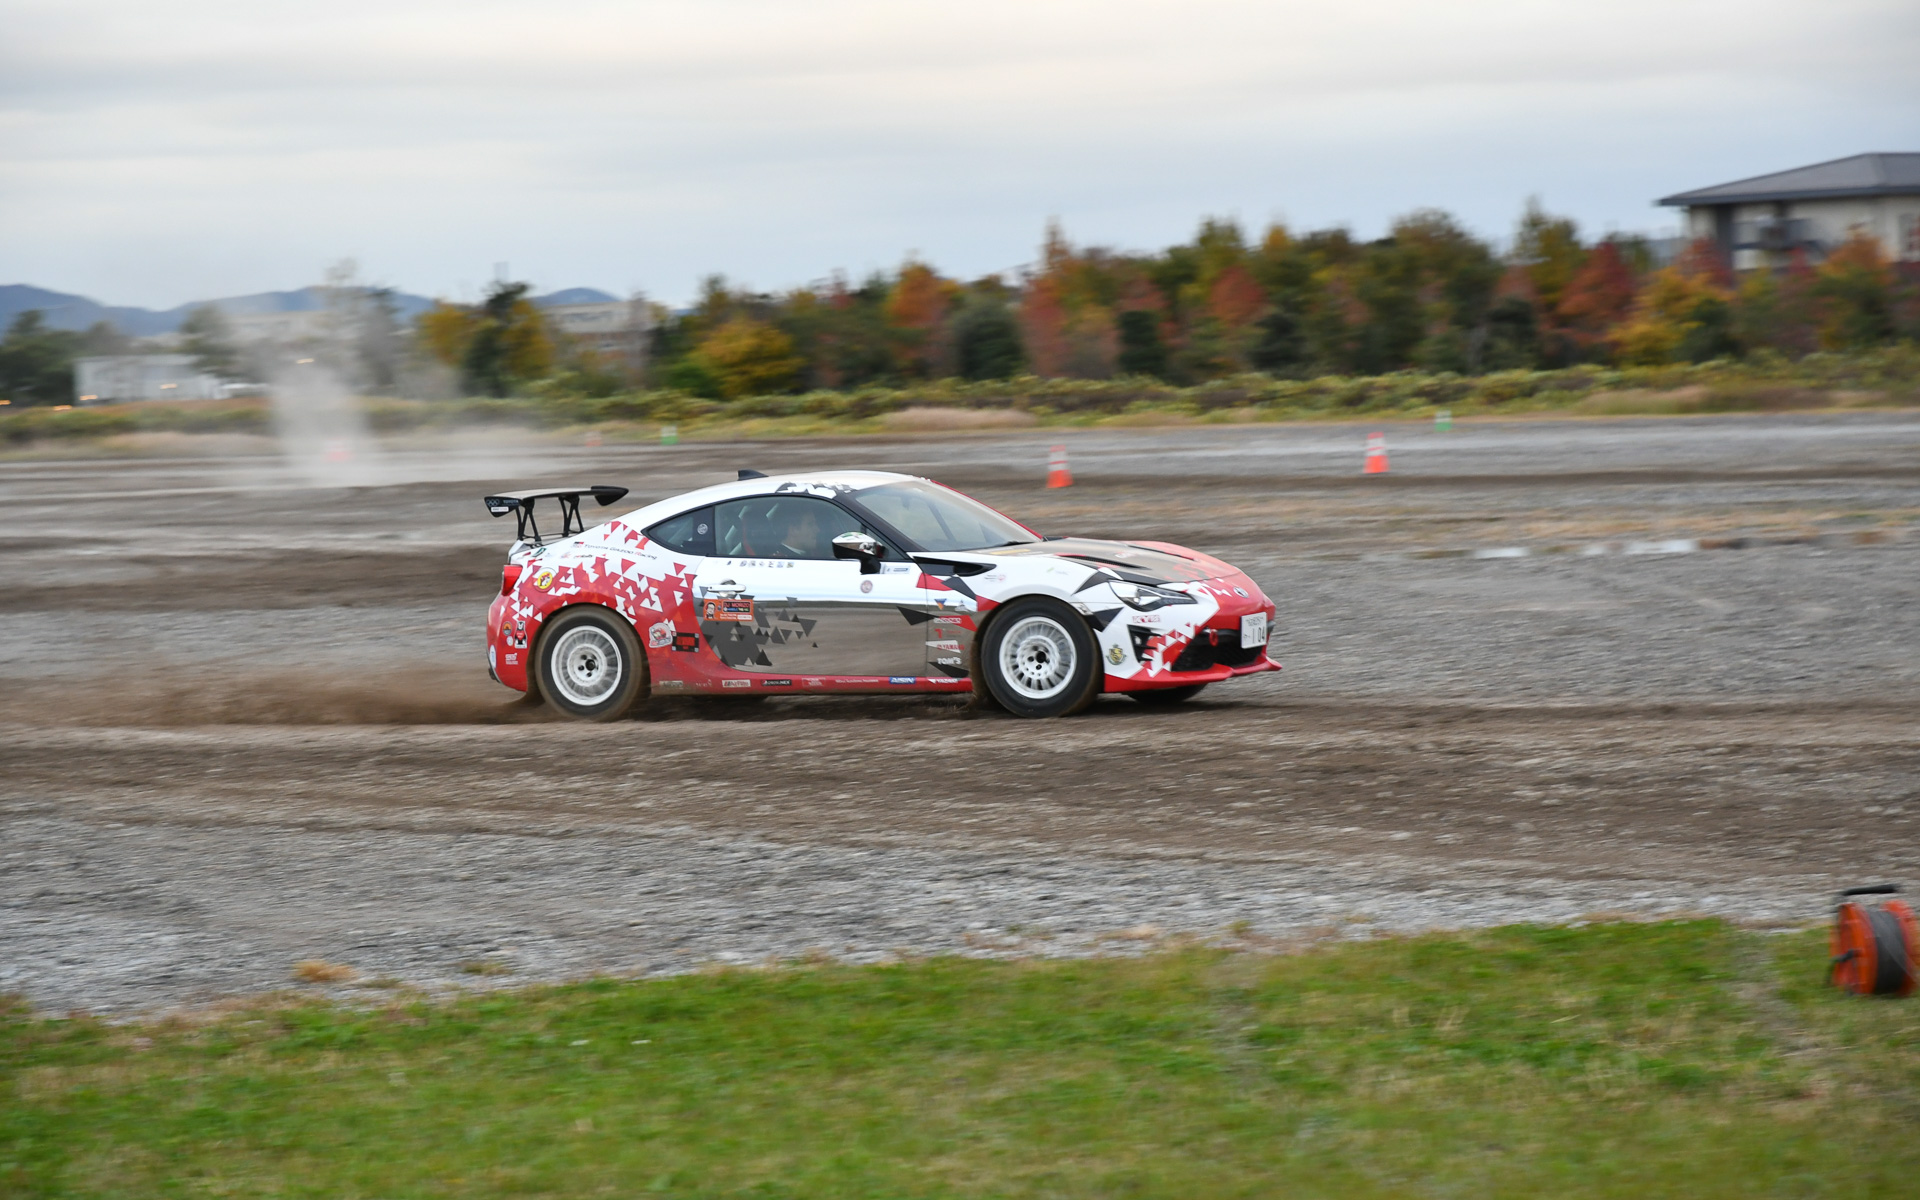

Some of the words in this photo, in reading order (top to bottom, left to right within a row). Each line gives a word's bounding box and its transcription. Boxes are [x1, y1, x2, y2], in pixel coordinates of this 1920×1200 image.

[609, 546, 634, 554] GAZOO
[634, 551, 658, 560] Racing
[937, 656, 962, 665] TOM'S
